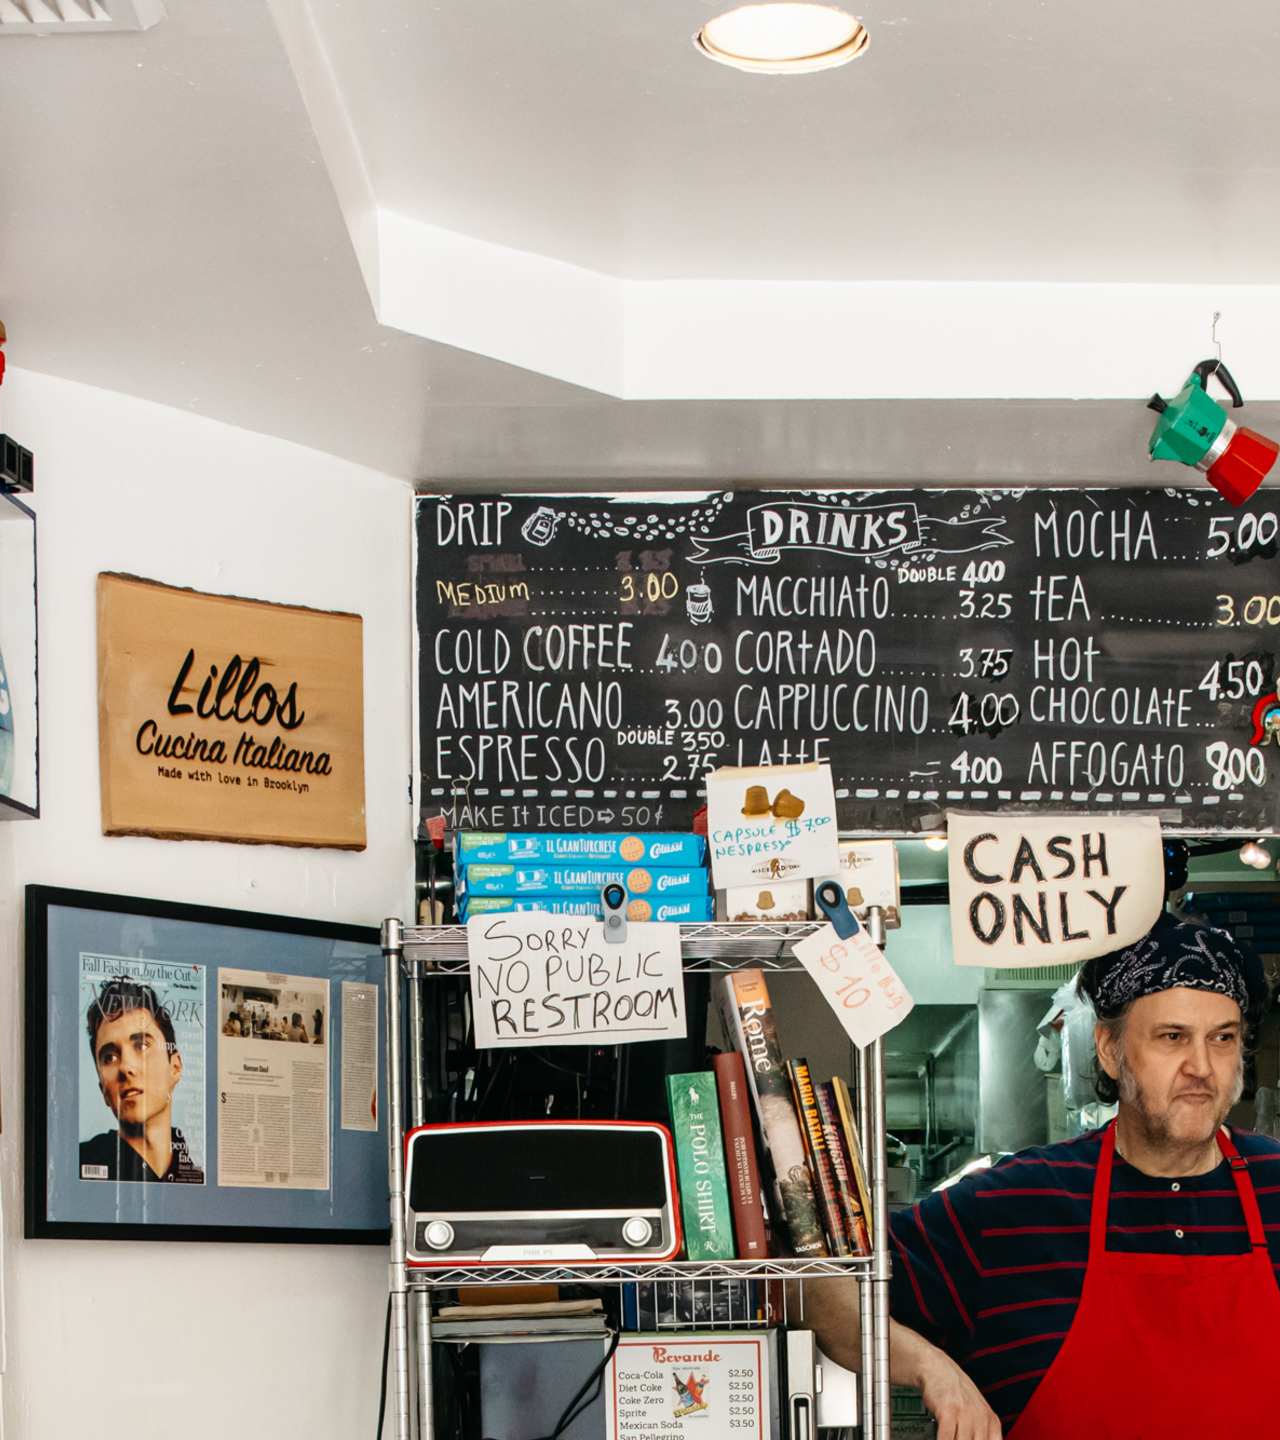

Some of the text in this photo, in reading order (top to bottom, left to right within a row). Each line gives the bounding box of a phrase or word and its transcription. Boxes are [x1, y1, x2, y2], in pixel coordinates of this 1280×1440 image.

[436, 502, 513, 546] DRIP
[761, 509, 908, 547] DRINKS
[1034, 510, 1158, 560] MOCHA
[620, 572, 679, 602] 3.00
[898, 566, 956, 584] DOUBLE
[960, 590, 1012, 619] 3.25
[435, 622, 634, 675] COLD COFFEE
[959, 649, 1013, 679] 3.75
[167, 648, 305, 730] Lillos
[1198, 661, 1263, 700] 4.50
[436, 680, 723, 730] AMERICANO 3.00
[734, 684, 1020, 734] CAPPUCCINO 4.00
[136, 719, 332, 777] Cucina Italiana
[617, 730, 674, 746] DOUBLE
[436, 736, 606, 783] ESPRESSO
[157, 766, 309, 793] Made with love in Brooklyn
[440, 805, 505, 829] MAKE
[537, 805, 593, 828] ICED
[712, 824, 777, 845] CAPSULE
[963, 832, 1111, 885] CASH
[969, 886, 1128, 945] ONLY
[483, 920, 591, 962] SORRY
[82, 958, 100, 972] Fall
[157, 968, 172, 979] the
[173, 969, 192, 983] Cut
[476, 951, 665, 999] NO PUBLIC
[492, 986, 679, 1036] RESTROOM
[742, 999, 772, 1073] Rome
[795, 1065, 826, 1151] MARIO BATALI
[690, 1124, 716, 1233] POLO SHIRT
[652, 1346, 721, 1364] Bevande
[618, 1369, 754, 1382] Coca-Cola $2.50
[619, 1382, 754, 1393] Diet Coke $2.50
[619, 1394, 755, 1405] Coke Zero $2.50
[619, 1406, 755, 1419] Sprite $2.50
[619, 1419, 755, 1431] Mexican Soda $3.50
